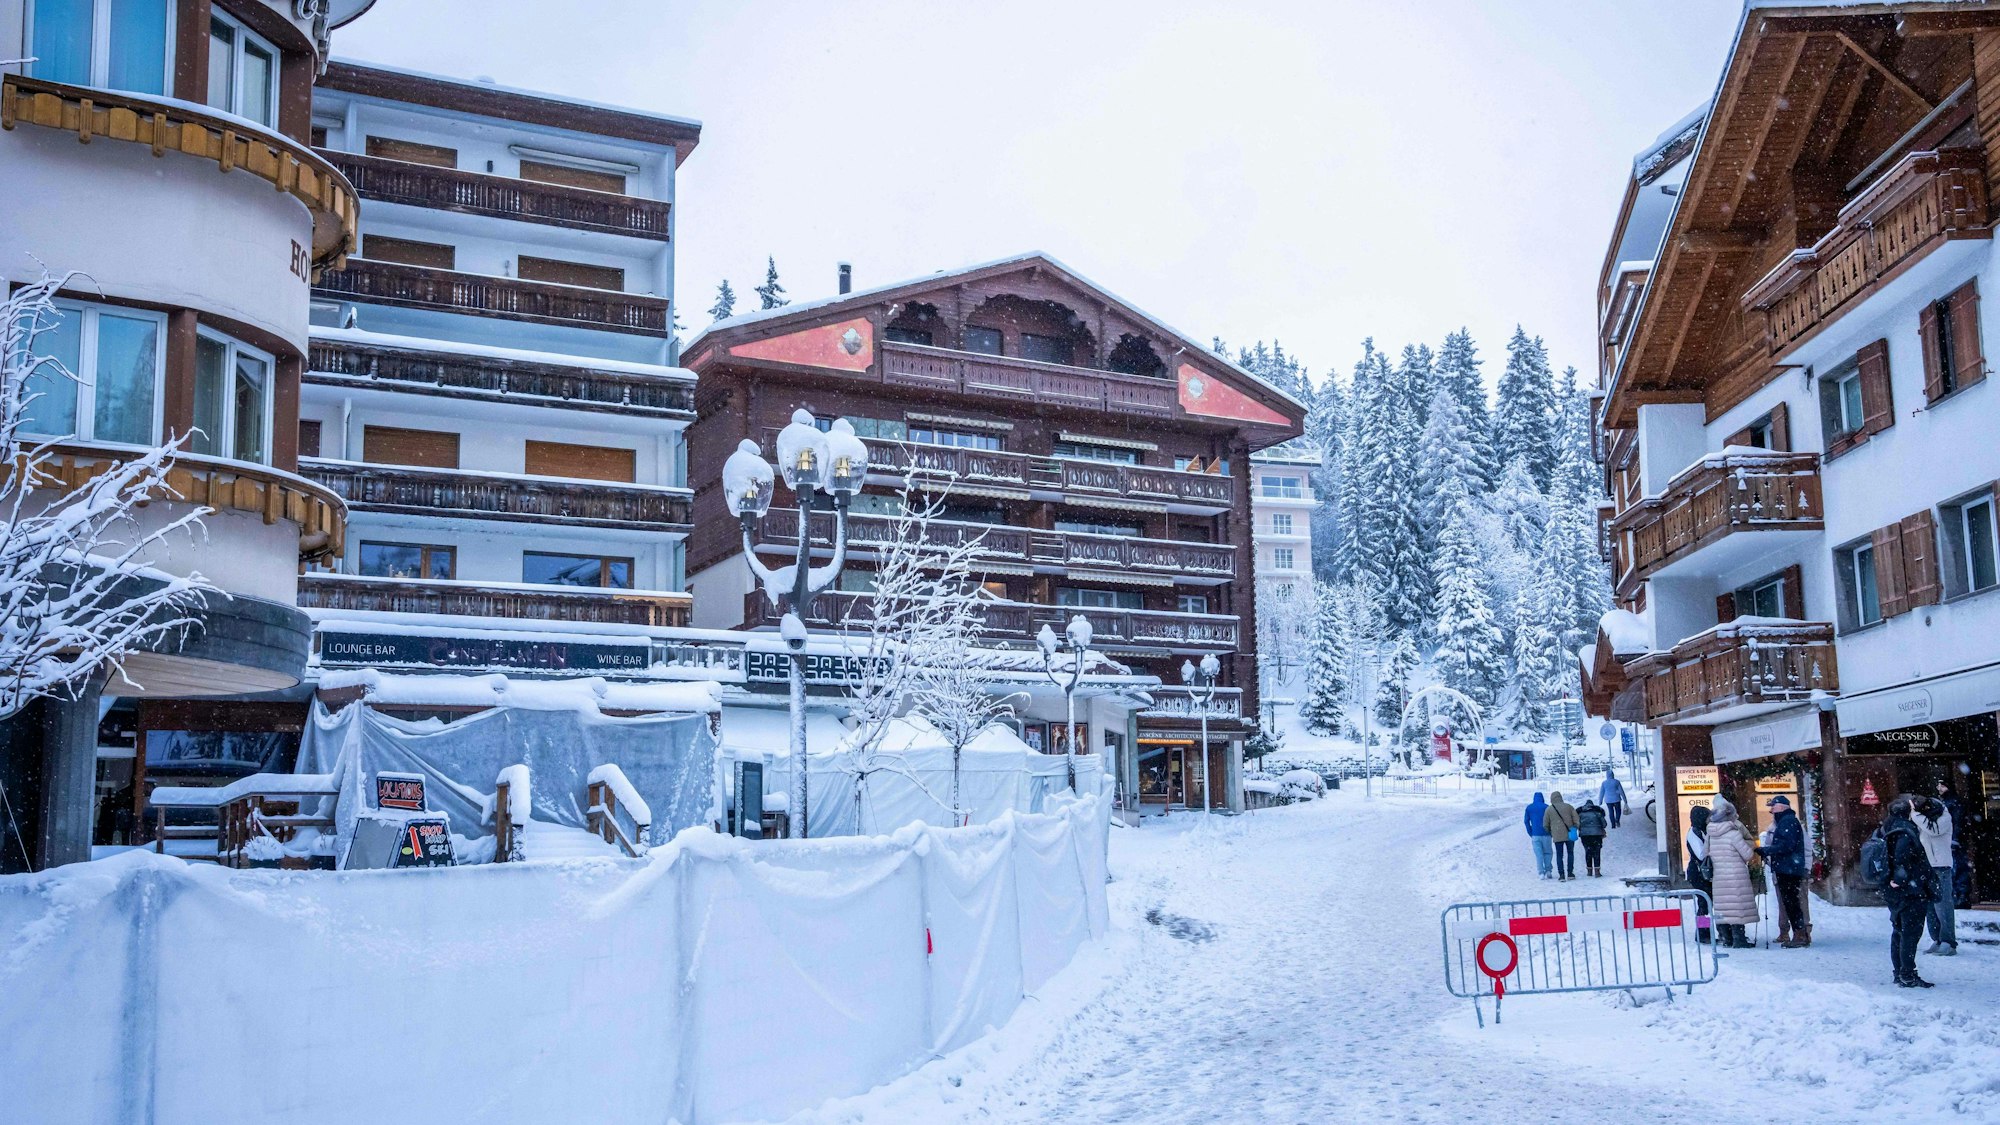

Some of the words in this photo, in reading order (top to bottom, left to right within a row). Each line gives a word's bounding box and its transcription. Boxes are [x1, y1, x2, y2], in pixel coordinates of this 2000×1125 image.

[290, 238, 311, 289] HO
[328, 643, 373, 655] LOUNGE
[374, 645, 396, 655] BAR
[597, 654, 622, 665] WINE
[623, 655, 642, 665] BAR
[1873, 731, 1930, 741] SAEGESSER
[379, 781, 422, 800] LOCATIONS
[420, 825, 443, 836] SNOW
[429, 844, 449, 856] SKI
